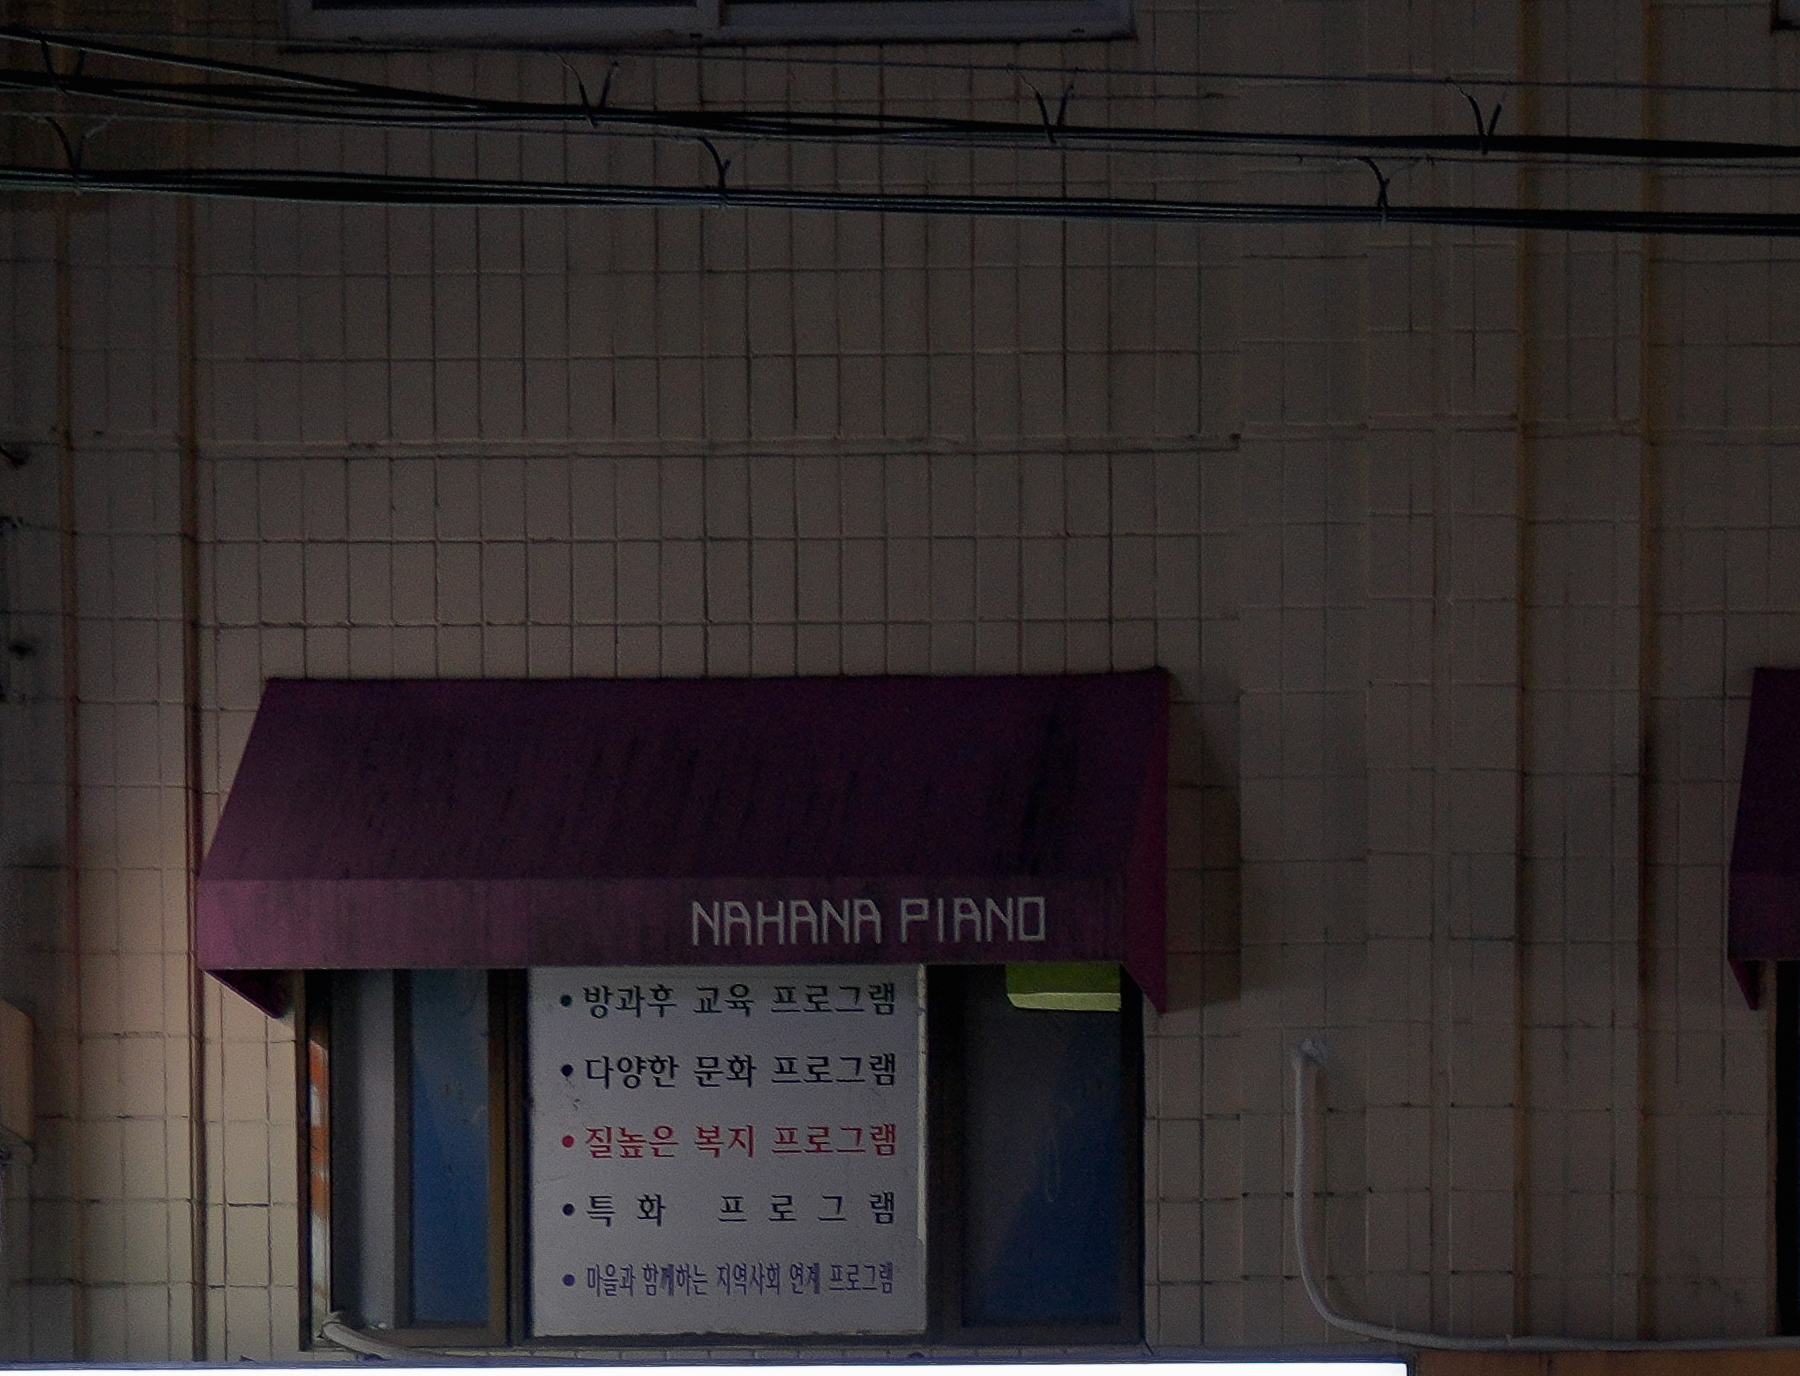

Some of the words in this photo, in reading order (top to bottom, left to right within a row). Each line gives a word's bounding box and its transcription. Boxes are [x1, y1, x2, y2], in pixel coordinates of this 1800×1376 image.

[691, 900, 883, 946] NAHANA
[901, 896, 1047, 944] PIANO
[583, 982, 678, 1019] 방과후
[694, 983, 755, 1017] 교육
[771, 981, 896, 1017] 프로그램
[584, 1054, 680, 1090] 다양한
[694, 1054, 757, 1089] 문화
[771, 1051, 896, 1087] 프로그램
[585, 1124, 679, 1159] 질높은
[694, 1124, 756, 1159] 복지
[771, 1123, 897, 1157] 프로그램
[586, 1263, 636, 1298] 마을과
[643, 1262, 709, 1297] 함께하는
[716, 1262, 781, 1296] 지역사회
[789, 1262, 821, 1295] 연계
[829, 1261, 894, 1295] 프로그램
